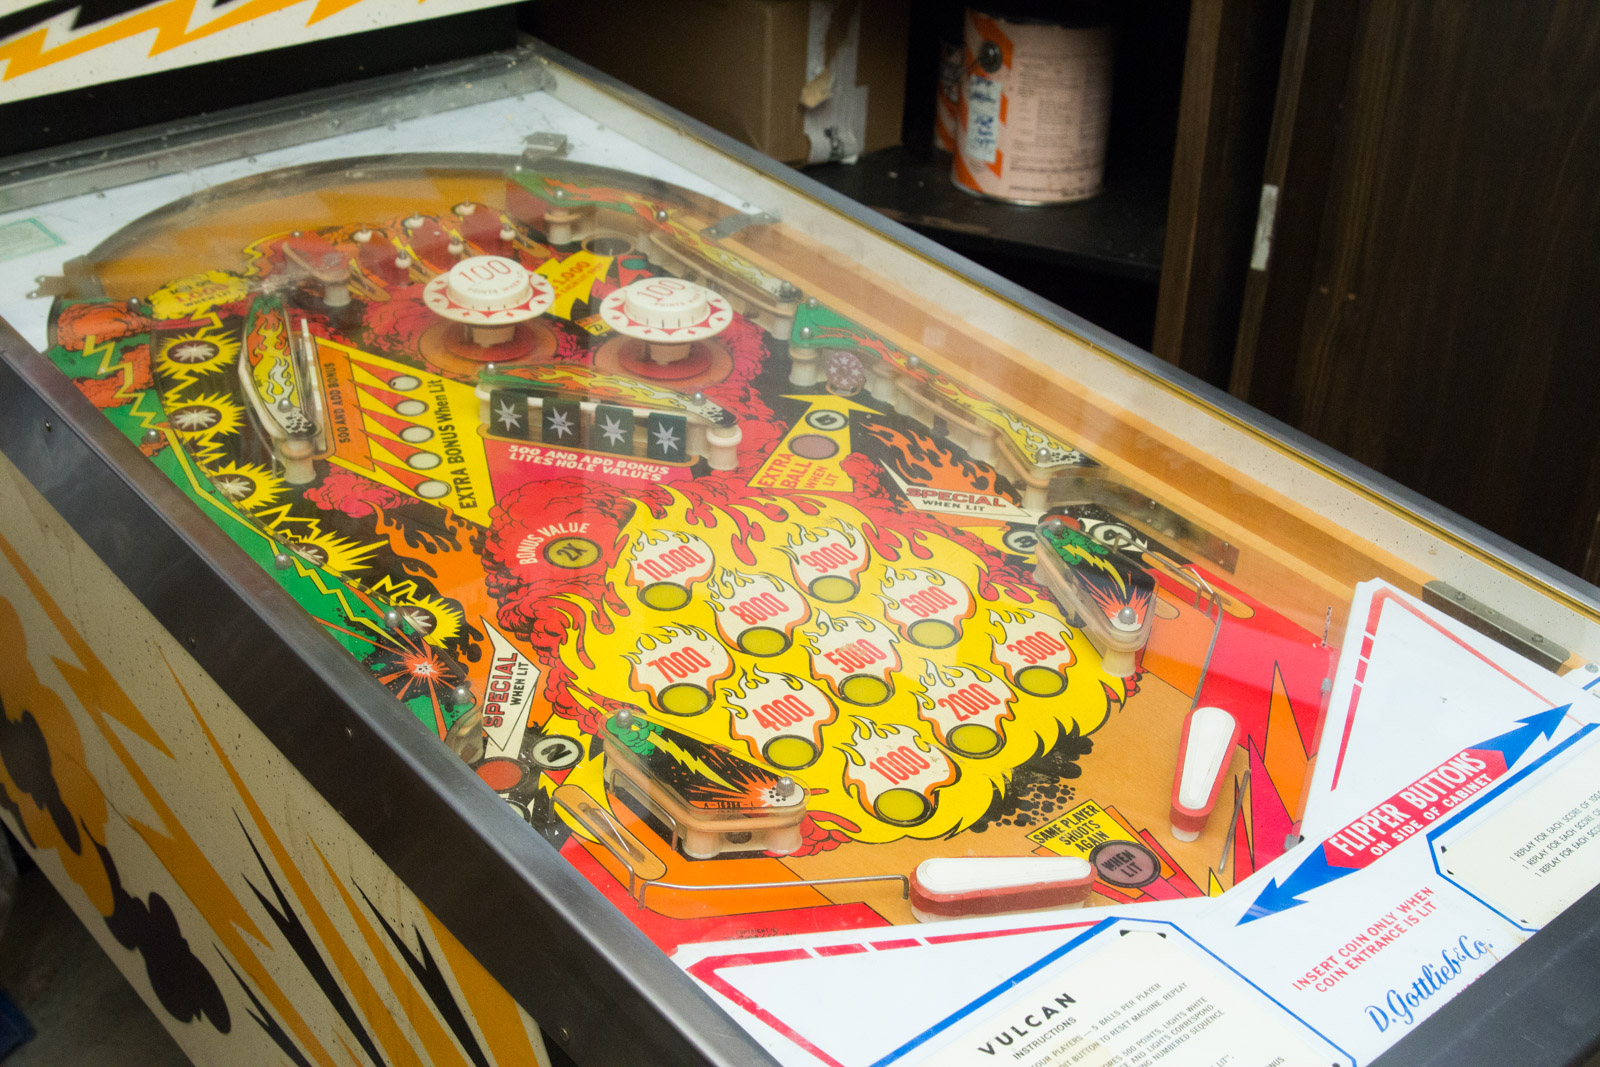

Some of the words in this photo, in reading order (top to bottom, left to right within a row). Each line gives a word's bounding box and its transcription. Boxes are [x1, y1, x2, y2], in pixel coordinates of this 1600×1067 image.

[459, 259, 511, 282] 100
[637, 279, 686, 303] 100
[323, 362, 339, 388] BONUS
[427, 379, 446, 394] Lit
[330, 388, 342, 405] ADD
[434, 395, 453, 424] When
[334, 408, 346, 425] AND
[339, 428, 351, 444] 500
[438, 425, 465, 464] BONUS
[508, 445, 541, 455] 500
[545, 450, 578, 461] AND
[581, 455, 613, 466] ADD
[616, 461, 669, 475] BONUS
[509, 453, 553, 466] LITES
[555, 460, 597, 472] HOLE
[602, 466, 662, 482] VALUES
[757, 453, 795, 487] EXTRA
[780, 462, 813, 489] BALL
[450, 467, 477, 510] EXTRA
[804, 466, 828, 489] WHEN
[822, 473, 839, 486] LIT
[906, 487, 1006, 508] SPECIAL
[923, 500, 960, 508] WHEN
[516, 534, 544, 565] BONUS
[537, 522, 590, 537] VALUE
[556, 543, 589, 561] 2X
[800, 543, 858, 574] 9000
[637, 545, 705, 582] 10,000
[729, 592, 790, 626] 8000
[900, 586, 957, 618] 6000
[646, 646, 711, 684] 7000
[823, 638, 887, 674] 5000
[1006, 631, 1066, 665] 3000
[517, 662, 529, 678] LIT
[484, 652, 518, 728] SPECIAL
[510, 678, 526, 706] WHEN
[938, 683, 1001, 722] 2000
[752, 694, 815, 732] 4000
[869, 745, 931, 785] 1000
[1328, 803, 1411, 857] FLIPPER
[1398, 751, 1487, 810] BUTTONS
[1370, 840, 1392, 856] ON
[1391, 820, 1423, 842] SIDE
[1422, 806, 1440, 820] OF
[1442, 773, 1493, 808] CABINET
[1033, 824, 1063, 844] SAME
[1060, 804, 1101, 829] PLAYER
[1058, 820, 1101, 846] SHOOTS
[1514, 841, 1536, 858] REPLAY
[1534, 832, 1549, 843] FOR
[1546, 820, 1565, 834] EACH
[1562, 807, 1582, 822] SCORE
[1580, 801, 1590, 809] OF
[1526, 849, 1549, 866] REPLAY
[1546, 840, 1562, 851] FOR
[1559, 828, 1578, 842] EACH
[1574, 815, 1595, 830] SCORE
[1075, 830, 1110, 853] AGAIN
[1539, 856, 1562, 874] REPLAY
[1559, 847, 1574, 859] FOR
[1571, 835, 1590, 849] EACH
[1101, 850, 1136, 871] WHEN
[1120, 862, 1143, 878] LIT
[1292, 955, 1339, 991] INSERT
[1338, 933, 1370, 958] COIN
[1367, 911, 1398, 936] ONLY
[1396, 886, 1435, 914] WHEN
[1315, 967, 1349, 993] COIN
[1345, 923, 1408, 970] ENTRANCE
[1403, 914, 1420, 927] IS
[1416, 901, 1437, 917] LIT
[977, 992, 1077, 1056] VULCAN
[1051, 1034, 1084, 1057] PLAYERS
[1091, 1024, 1099, 1032] 5
[1098, 1009, 1121, 1026] BALLS
[1120, 1000, 1135, 1012] PER
[1135, 982, 1162, 1002] PLAYER
[1071, 1041, 1101, 1063] BUTTON
[1099, 1034, 1112, 1044] TO
[1109, 1019, 1134, 1040] RESET
[1162, 981, 1189, 1001] REPEAT
[1122, 1045, 1137, 1057] 500
[1162, 1011, 1187, 1030] LIGHTS
[1185, 996, 1208, 1013] WHITE
[1152, 1032, 1190, 1062] NUMBERED
[1189, 1008, 1225, 1035] SEQUENCE
[1012, 1016, 1077, 1060] INSTRUCTIONS
[1130, 1050, 1147, 1064] AND
[1146, 1034, 1172, 1054] LIGHTS
